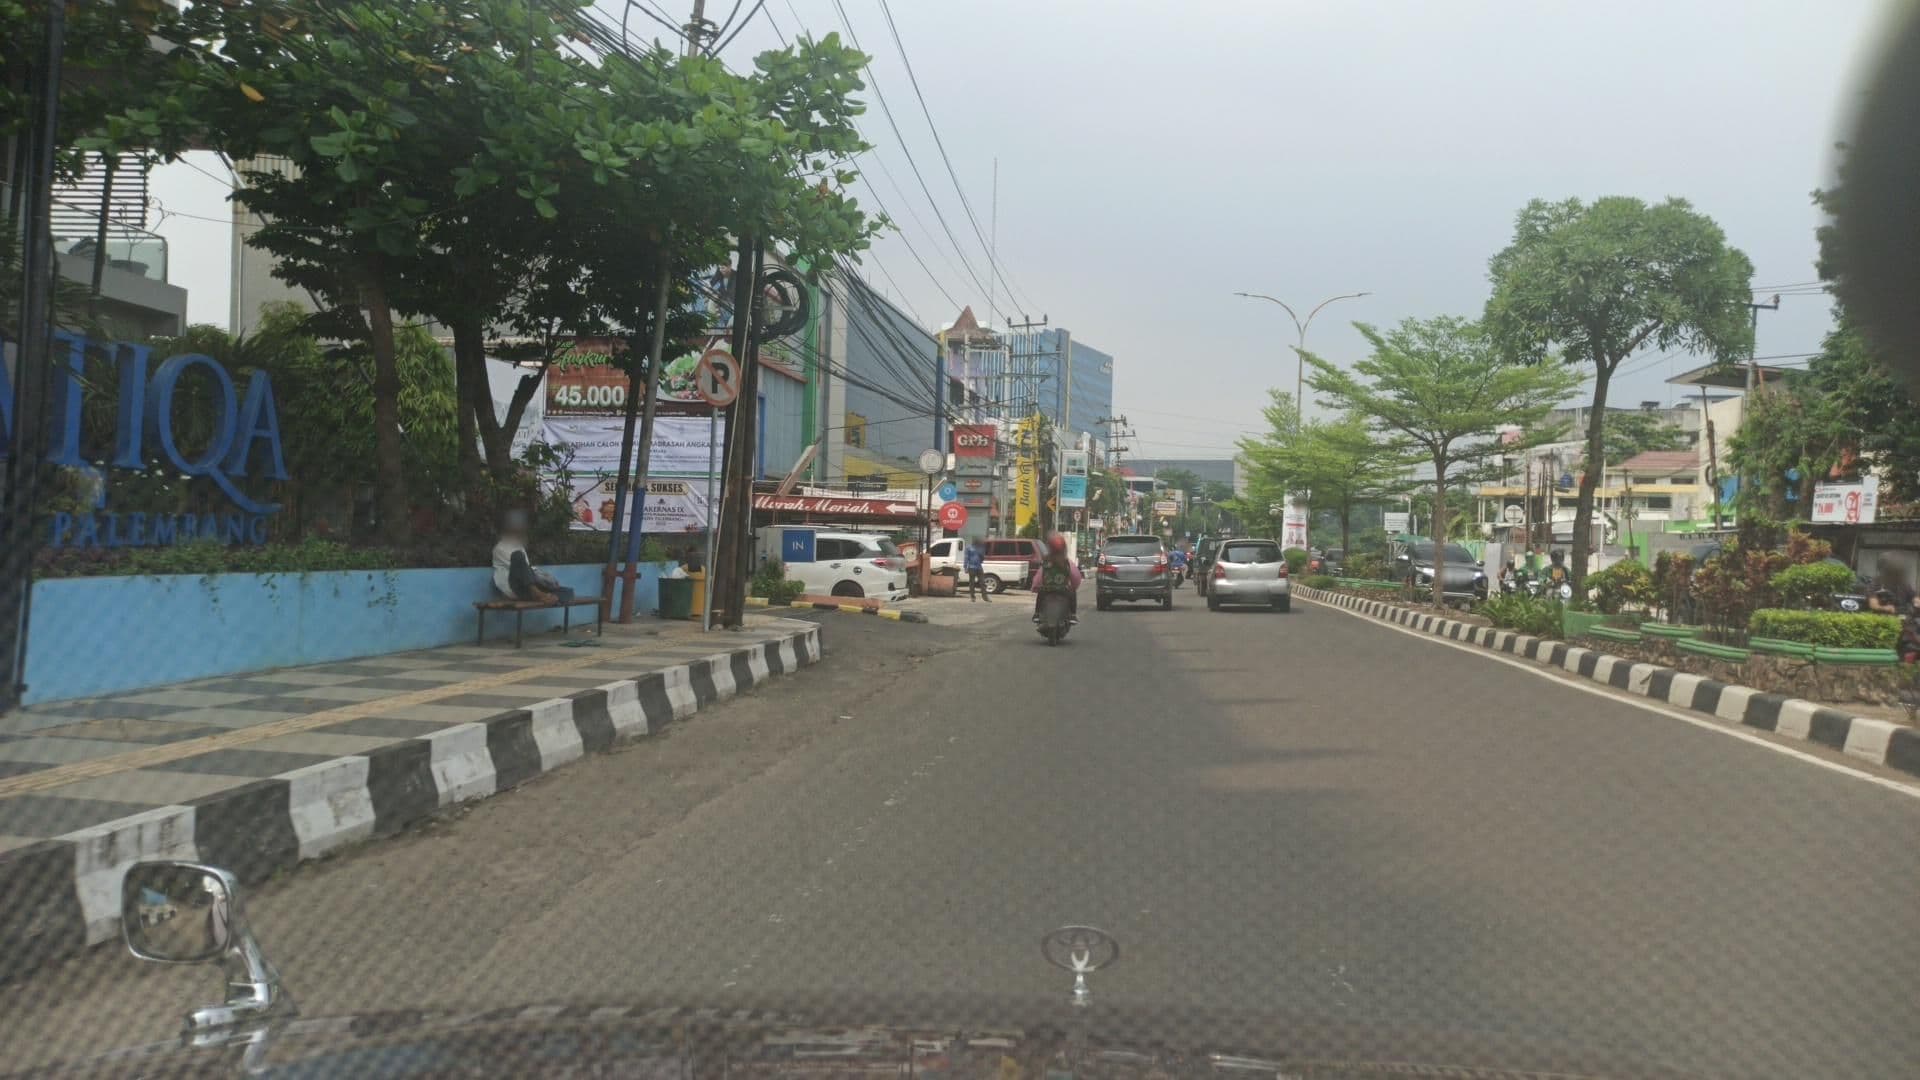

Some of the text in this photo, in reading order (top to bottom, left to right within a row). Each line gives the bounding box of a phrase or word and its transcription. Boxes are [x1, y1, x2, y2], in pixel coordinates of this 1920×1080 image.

[554, 385, 625, 407] 45.000
[0, 327, 290, 513] TIQA
[650, 483, 684, 493] SUKSES
[51, 510, 270, 548] PALEMBANG
[792, 541, 804, 551] IN
